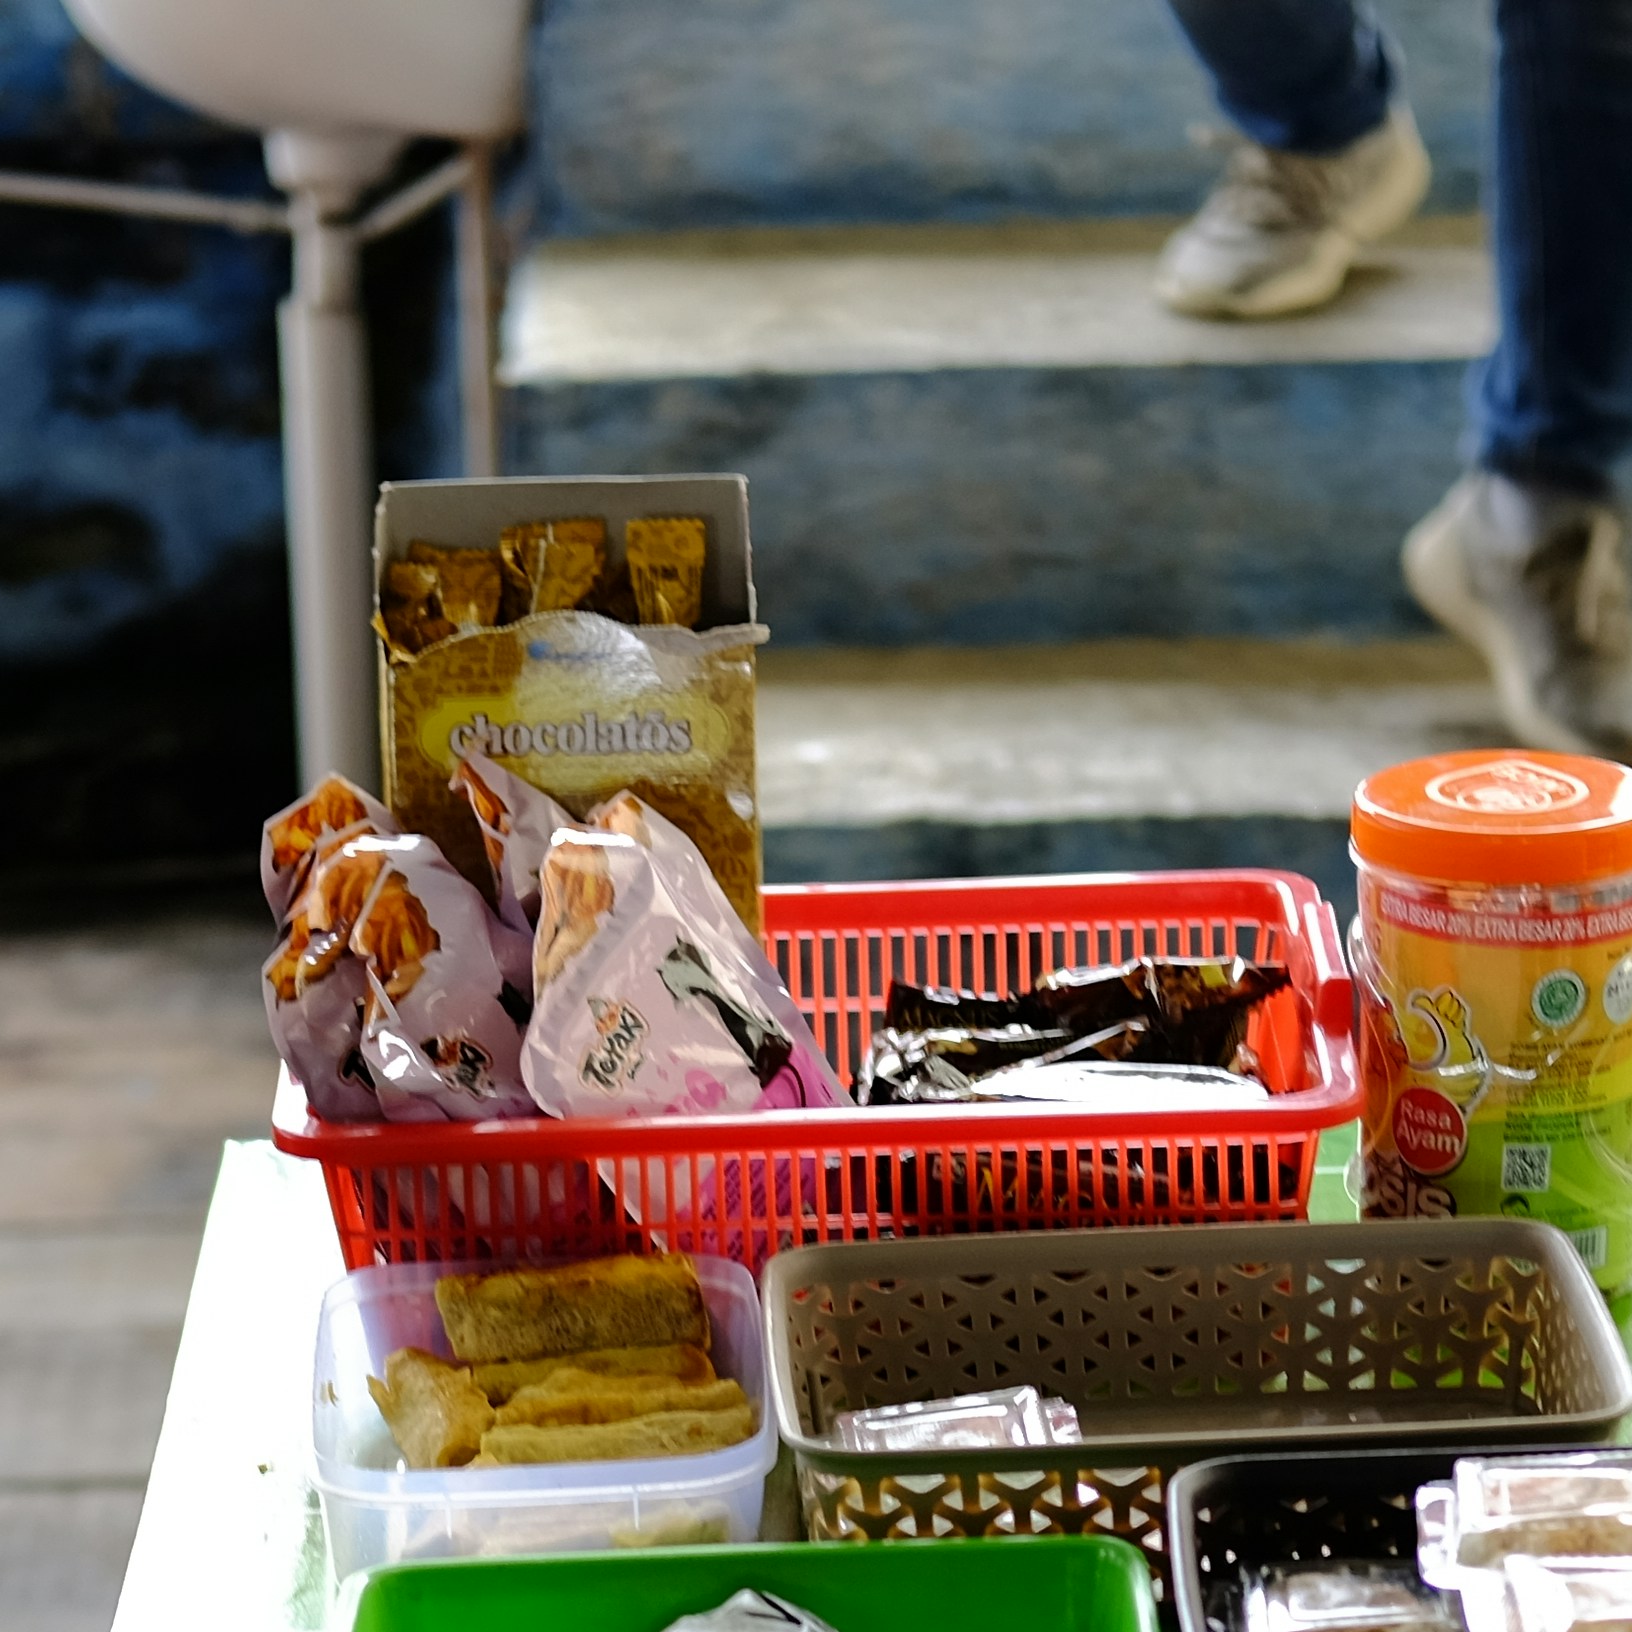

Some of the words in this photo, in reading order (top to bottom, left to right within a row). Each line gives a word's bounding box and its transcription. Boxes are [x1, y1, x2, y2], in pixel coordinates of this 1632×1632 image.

[1380, 891, 1408, 922] EXTRA
[1409, 902, 1447, 934] BESAR
[1474, 914, 1517, 941] EXTRA
[1518, 918, 1562, 942] BESAR
[1587, 909, 1618, 939] EXTRA
[1400, 1098, 1452, 1131] Rasa
[1396, 1120, 1462, 1156] Ayam
